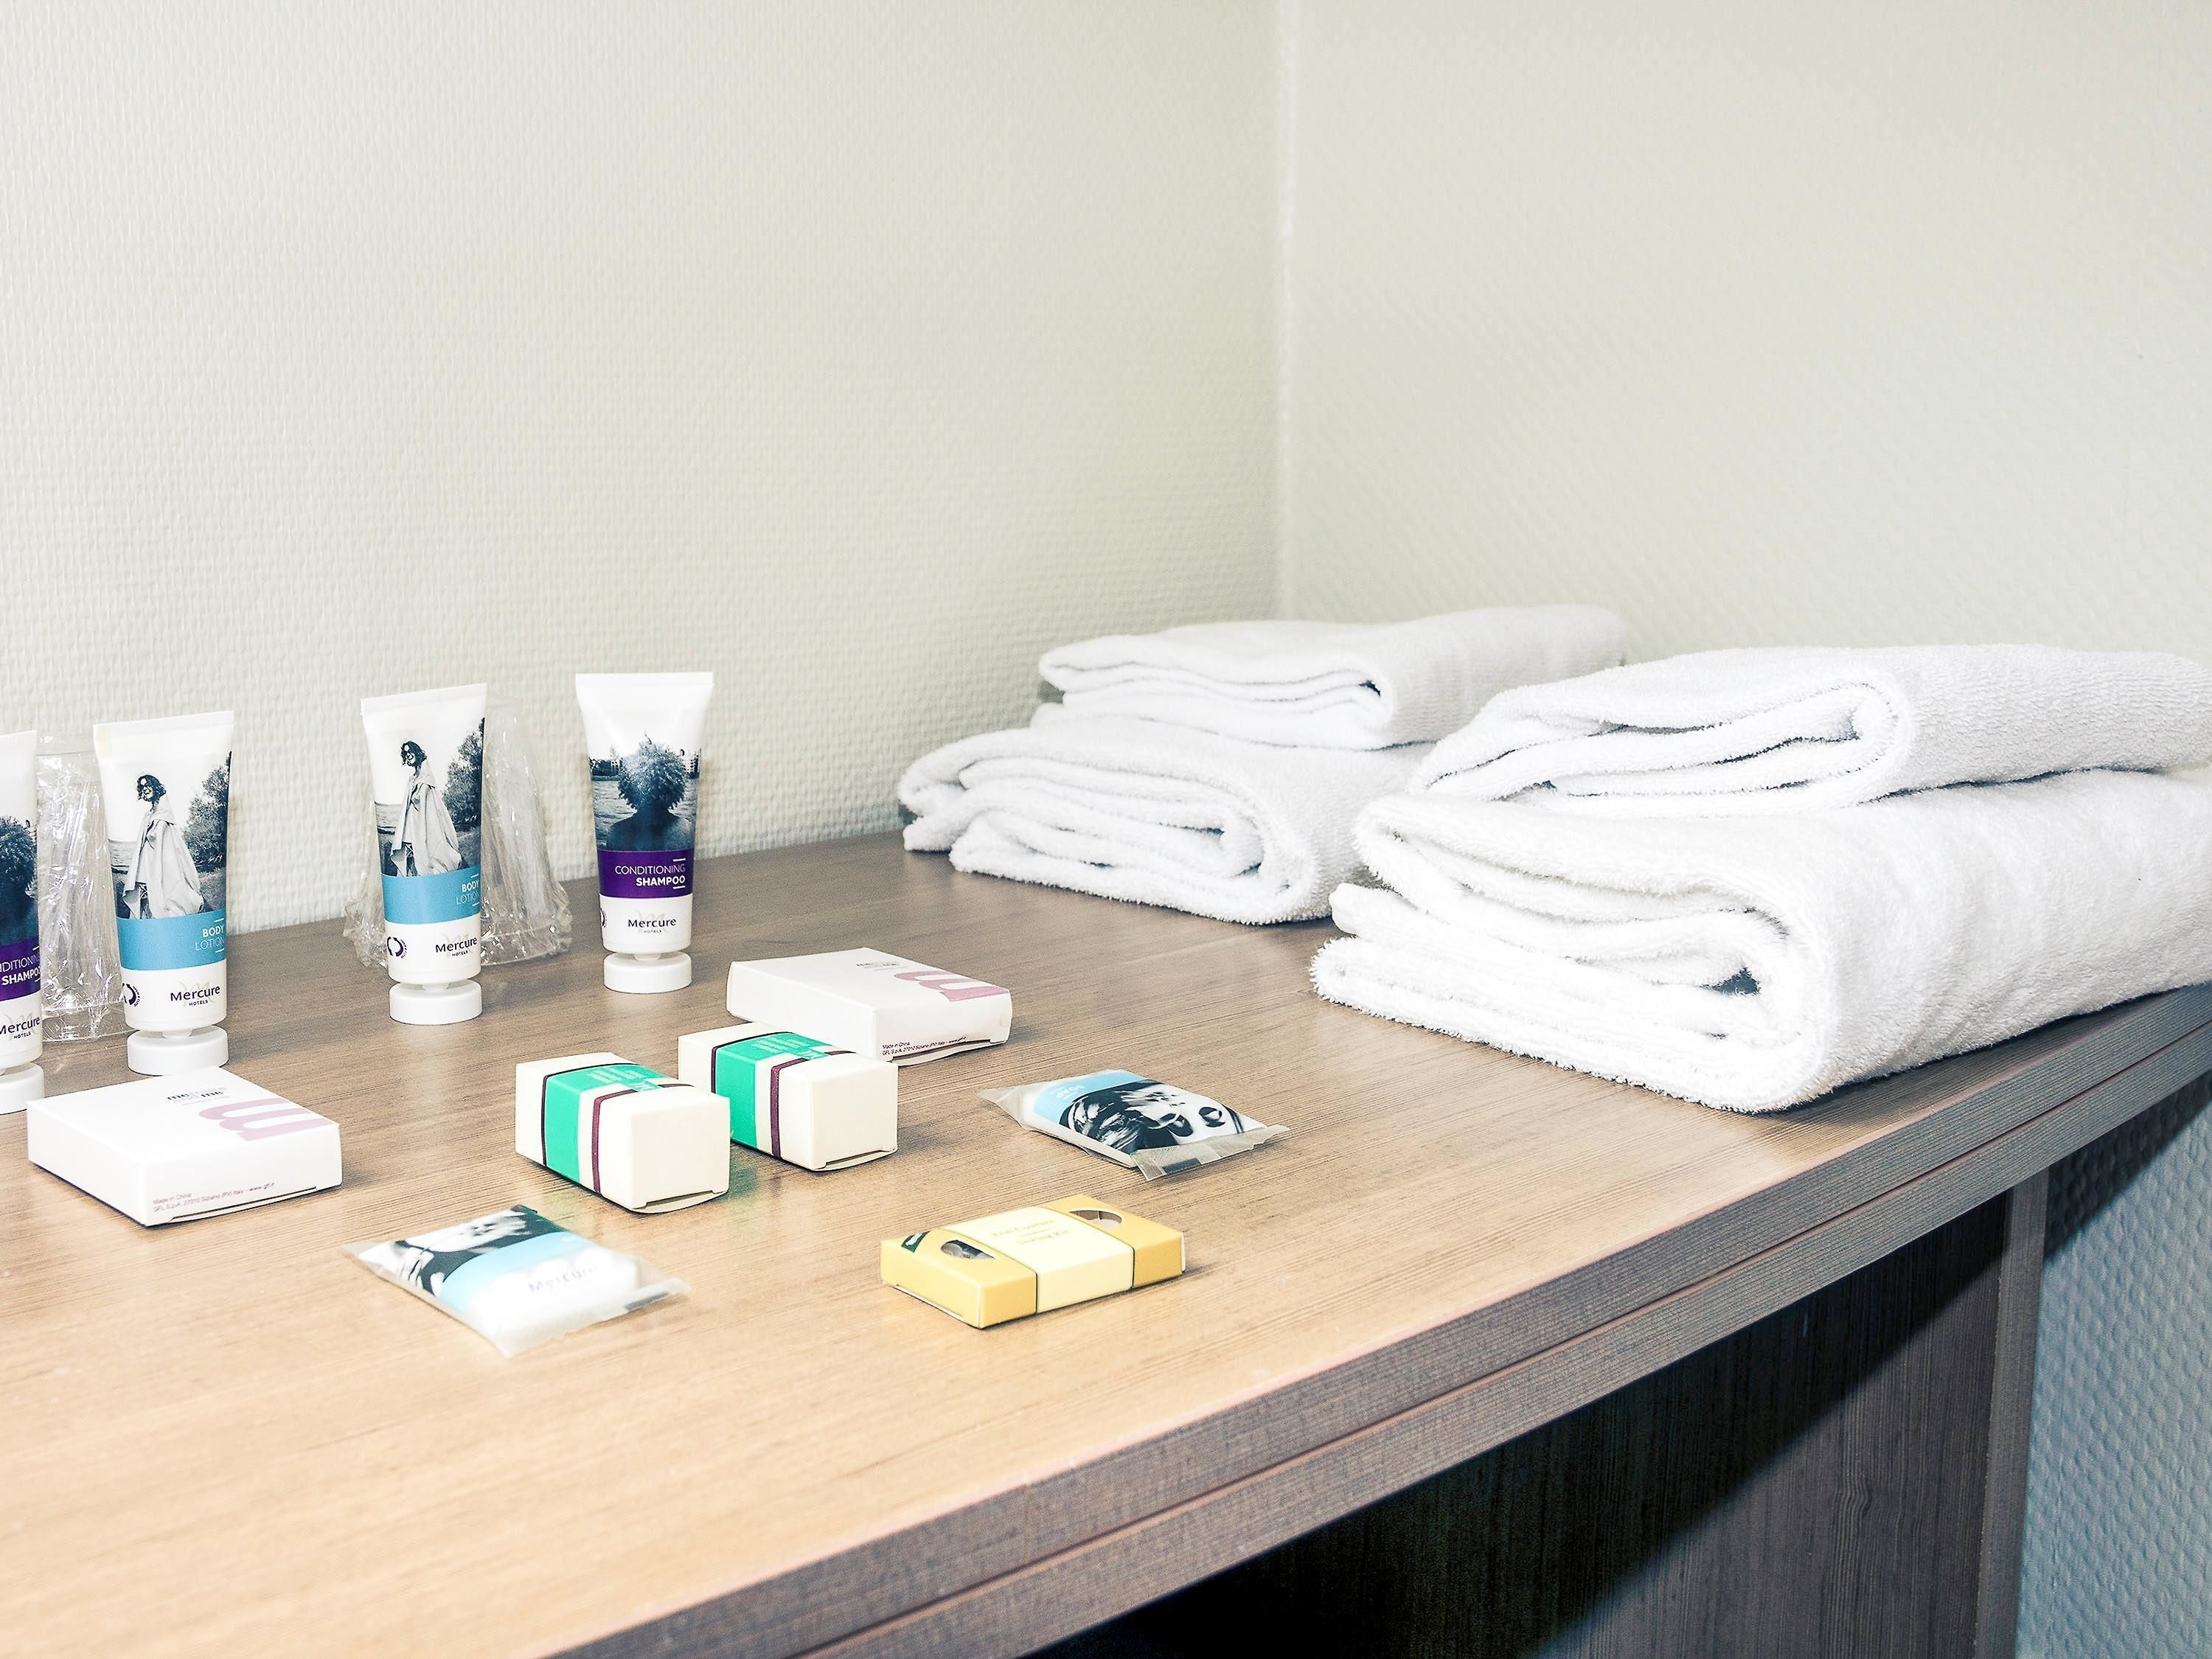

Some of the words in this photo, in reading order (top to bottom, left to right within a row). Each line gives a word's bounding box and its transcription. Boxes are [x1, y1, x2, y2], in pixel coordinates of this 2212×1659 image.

[614, 863, 686, 875] CONDITIONING
[462, 879, 479, 893] BODY
[636, 874, 686, 886] SHAMPOO
[627, 918, 677, 928] Mercure
[202, 925, 224, 938] BODY
[435, 937, 478, 953] Mercure
[170, 986, 220, 1002] Mercure
[13, 1031, 32, 1039] HOTELS
